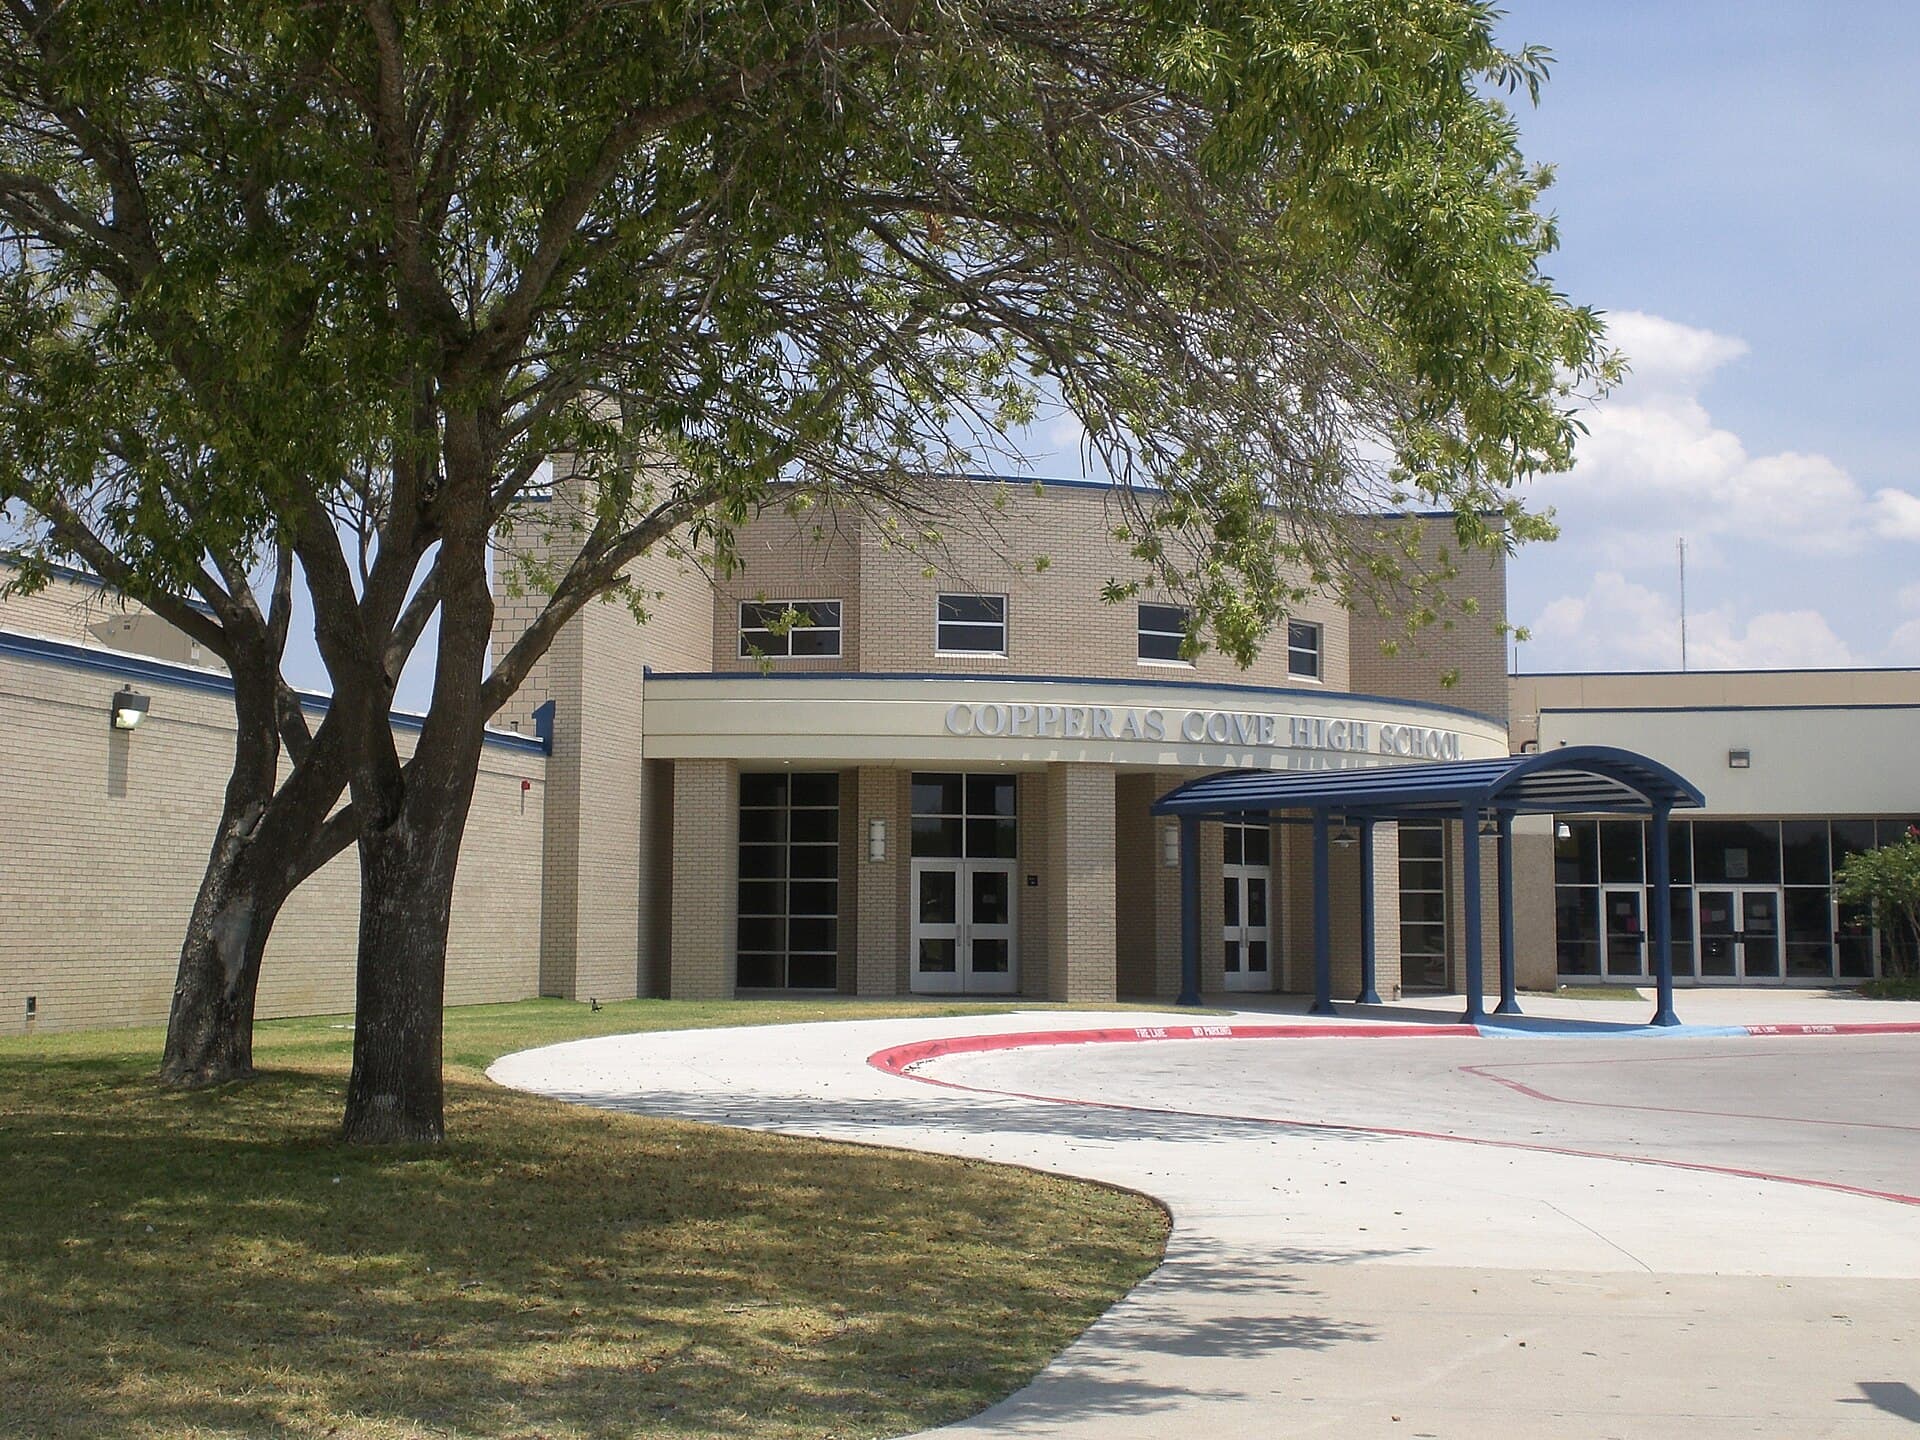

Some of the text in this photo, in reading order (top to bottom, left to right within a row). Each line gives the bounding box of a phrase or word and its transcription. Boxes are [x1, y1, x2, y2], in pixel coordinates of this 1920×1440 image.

[944, 703, 1464, 761] COPPERAS COVE HIGH SCHOOL
[1192, 1026, 1202, 1036] NO
